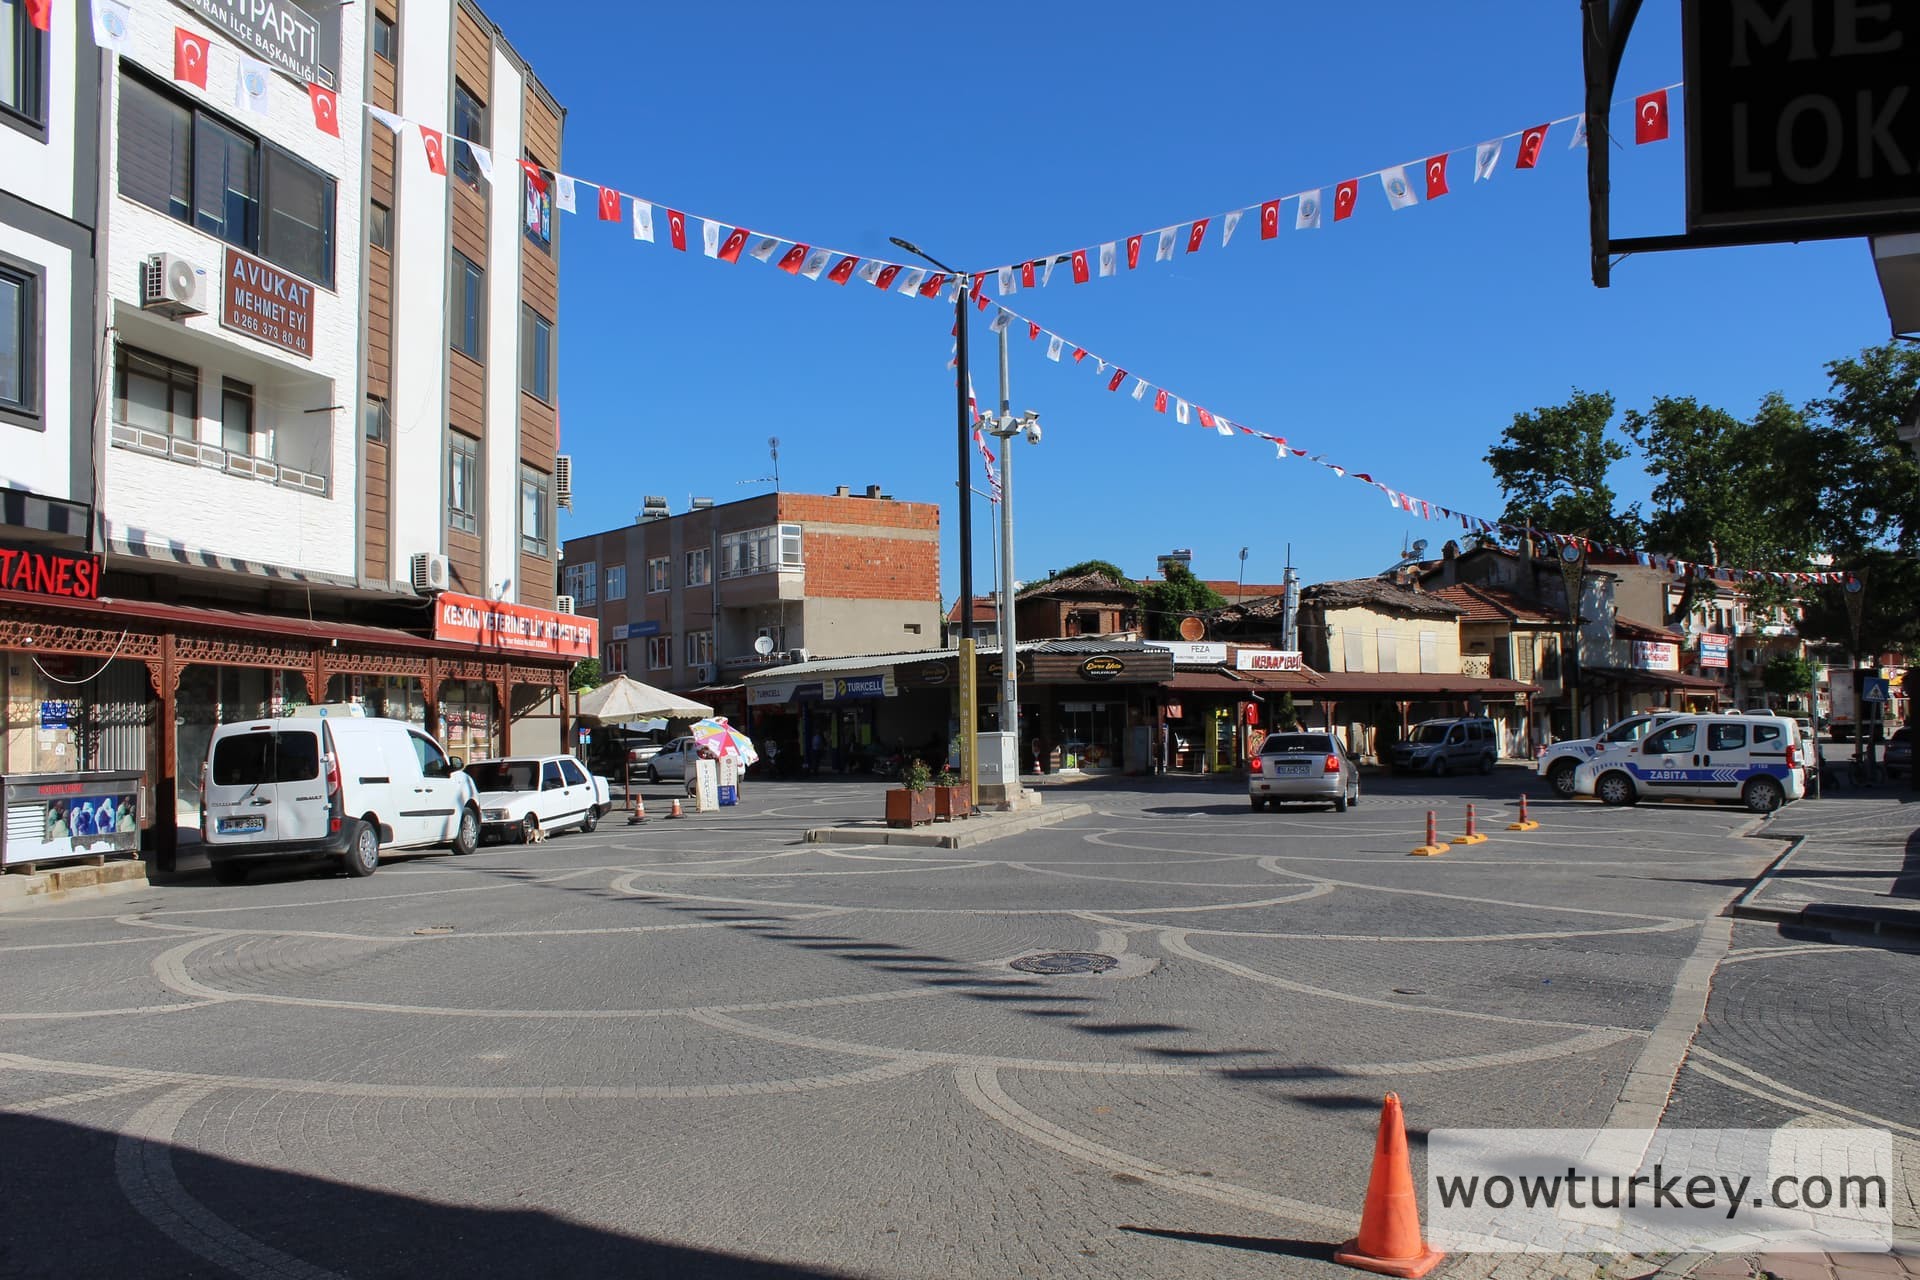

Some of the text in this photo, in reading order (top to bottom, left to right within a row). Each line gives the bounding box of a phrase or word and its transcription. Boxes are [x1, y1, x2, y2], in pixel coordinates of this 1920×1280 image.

[230, 12, 253, 41] İLÇE
[255, 33, 315, 84] BAŞKANLIĞI
[1732, 85, 1920, 189] LOK
[233, 257, 310, 309] AVUKAT
[233, 311, 306, 350] 0 266 373 80 40
[235, 287, 306, 333] MEHMET EYİ
[0, 548, 98, 599] TANESİ
[443, 603, 591, 645] KESKİN VETERİNERLİK HİZMETLERİ
[1191, 645, 1210, 653] FEZA
[847, 680, 882, 693] TURKCELL
[1649, 771, 1688, 780] ZABITA
